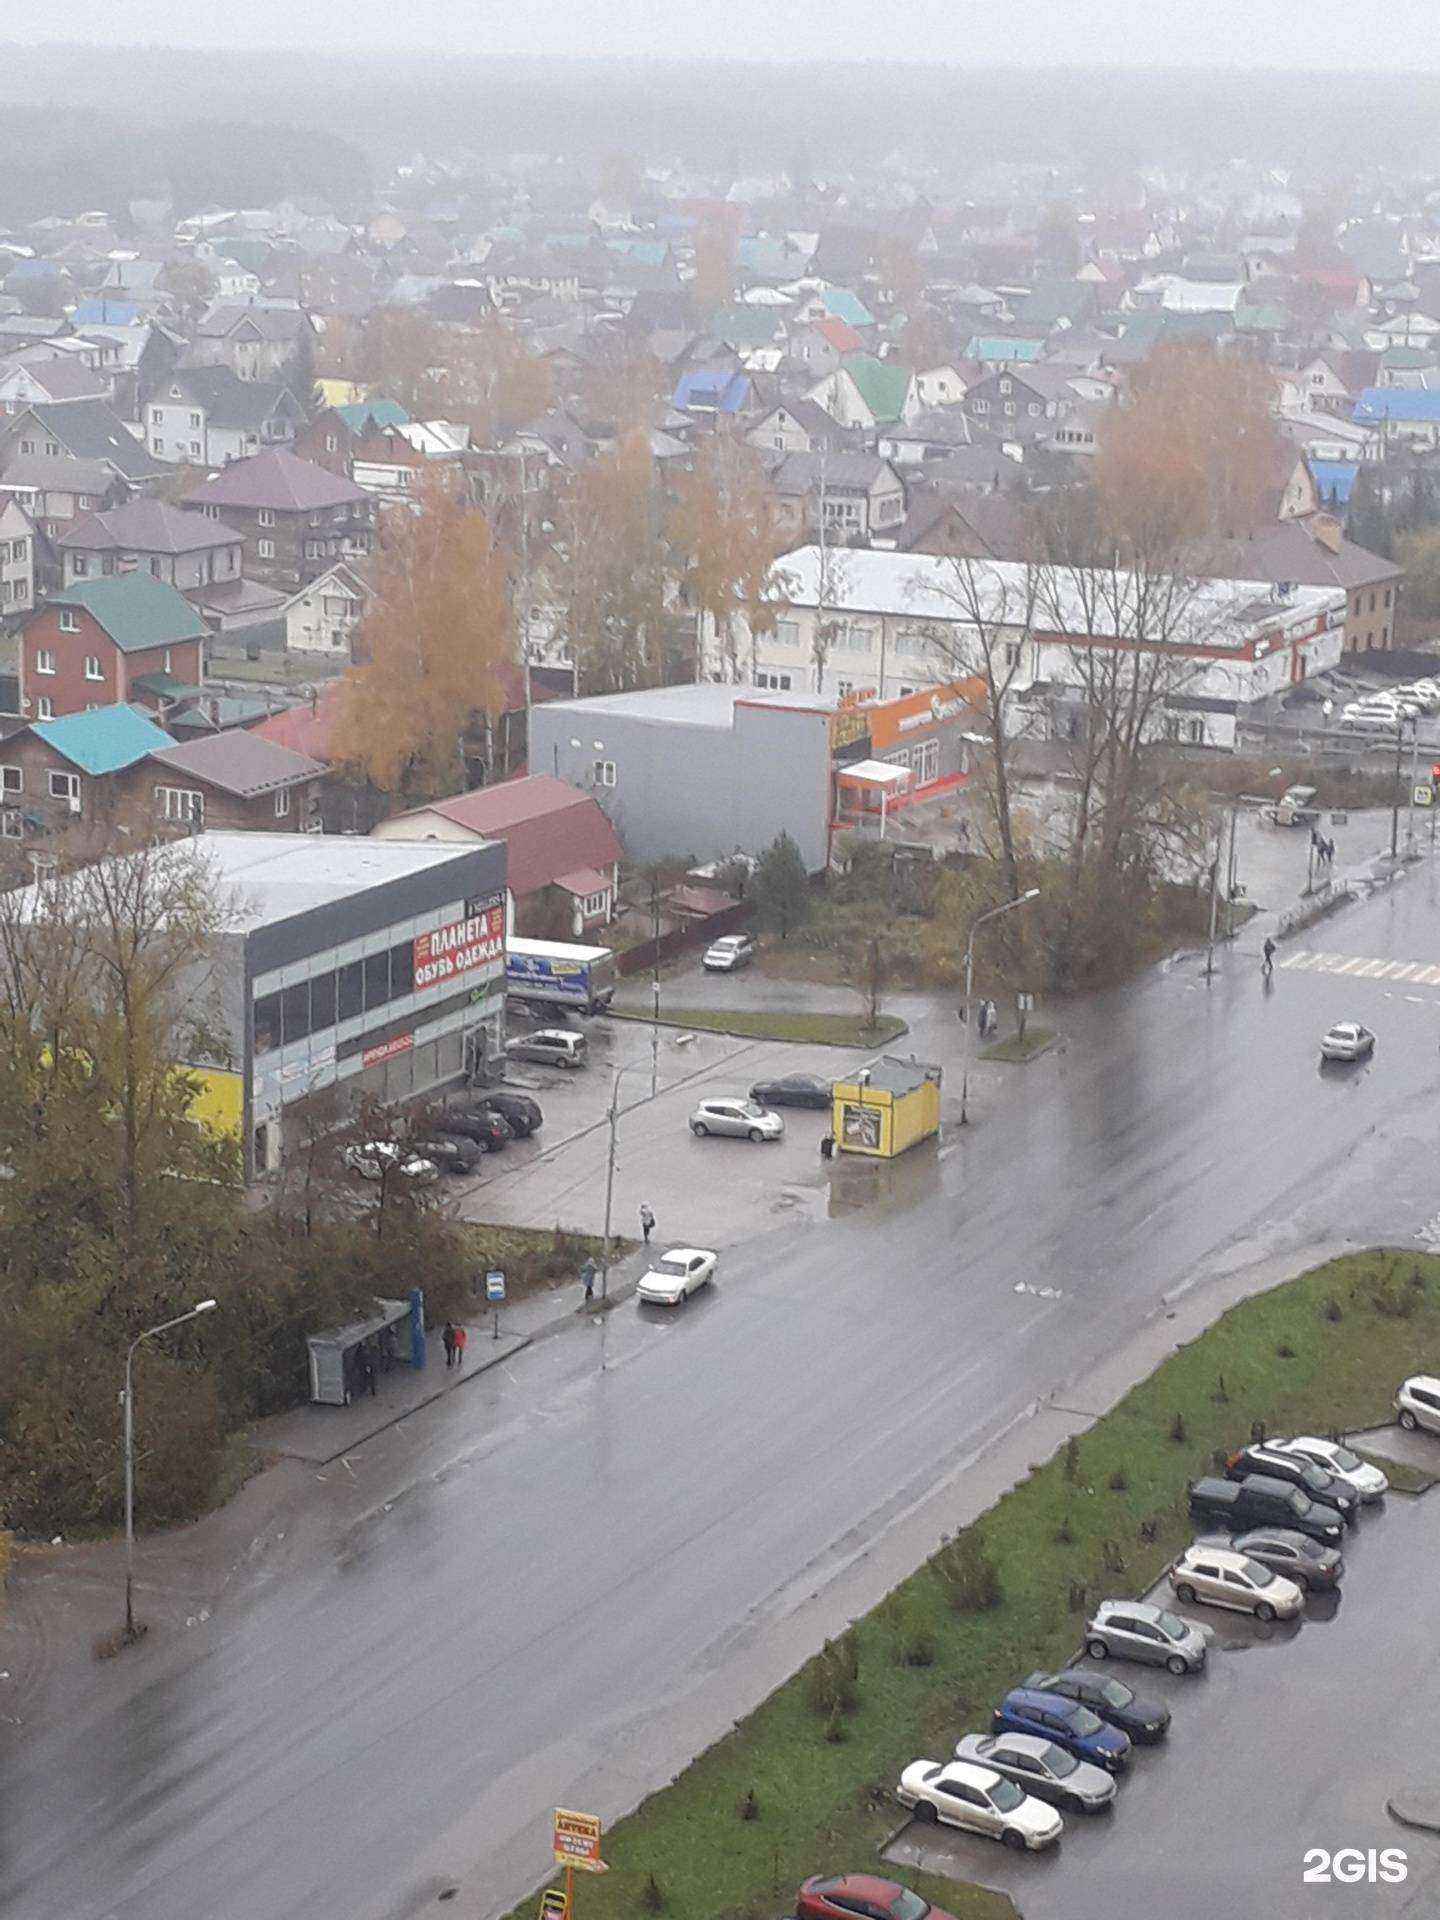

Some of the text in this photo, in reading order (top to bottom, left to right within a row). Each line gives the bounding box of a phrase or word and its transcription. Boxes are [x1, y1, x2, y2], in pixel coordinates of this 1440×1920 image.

[431, 914, 488, 956] ПЛАНЕТА
[415, 956, 454, 985] ОБУВЬ
[456, 937, 502, 970] ОДЕЖДА
